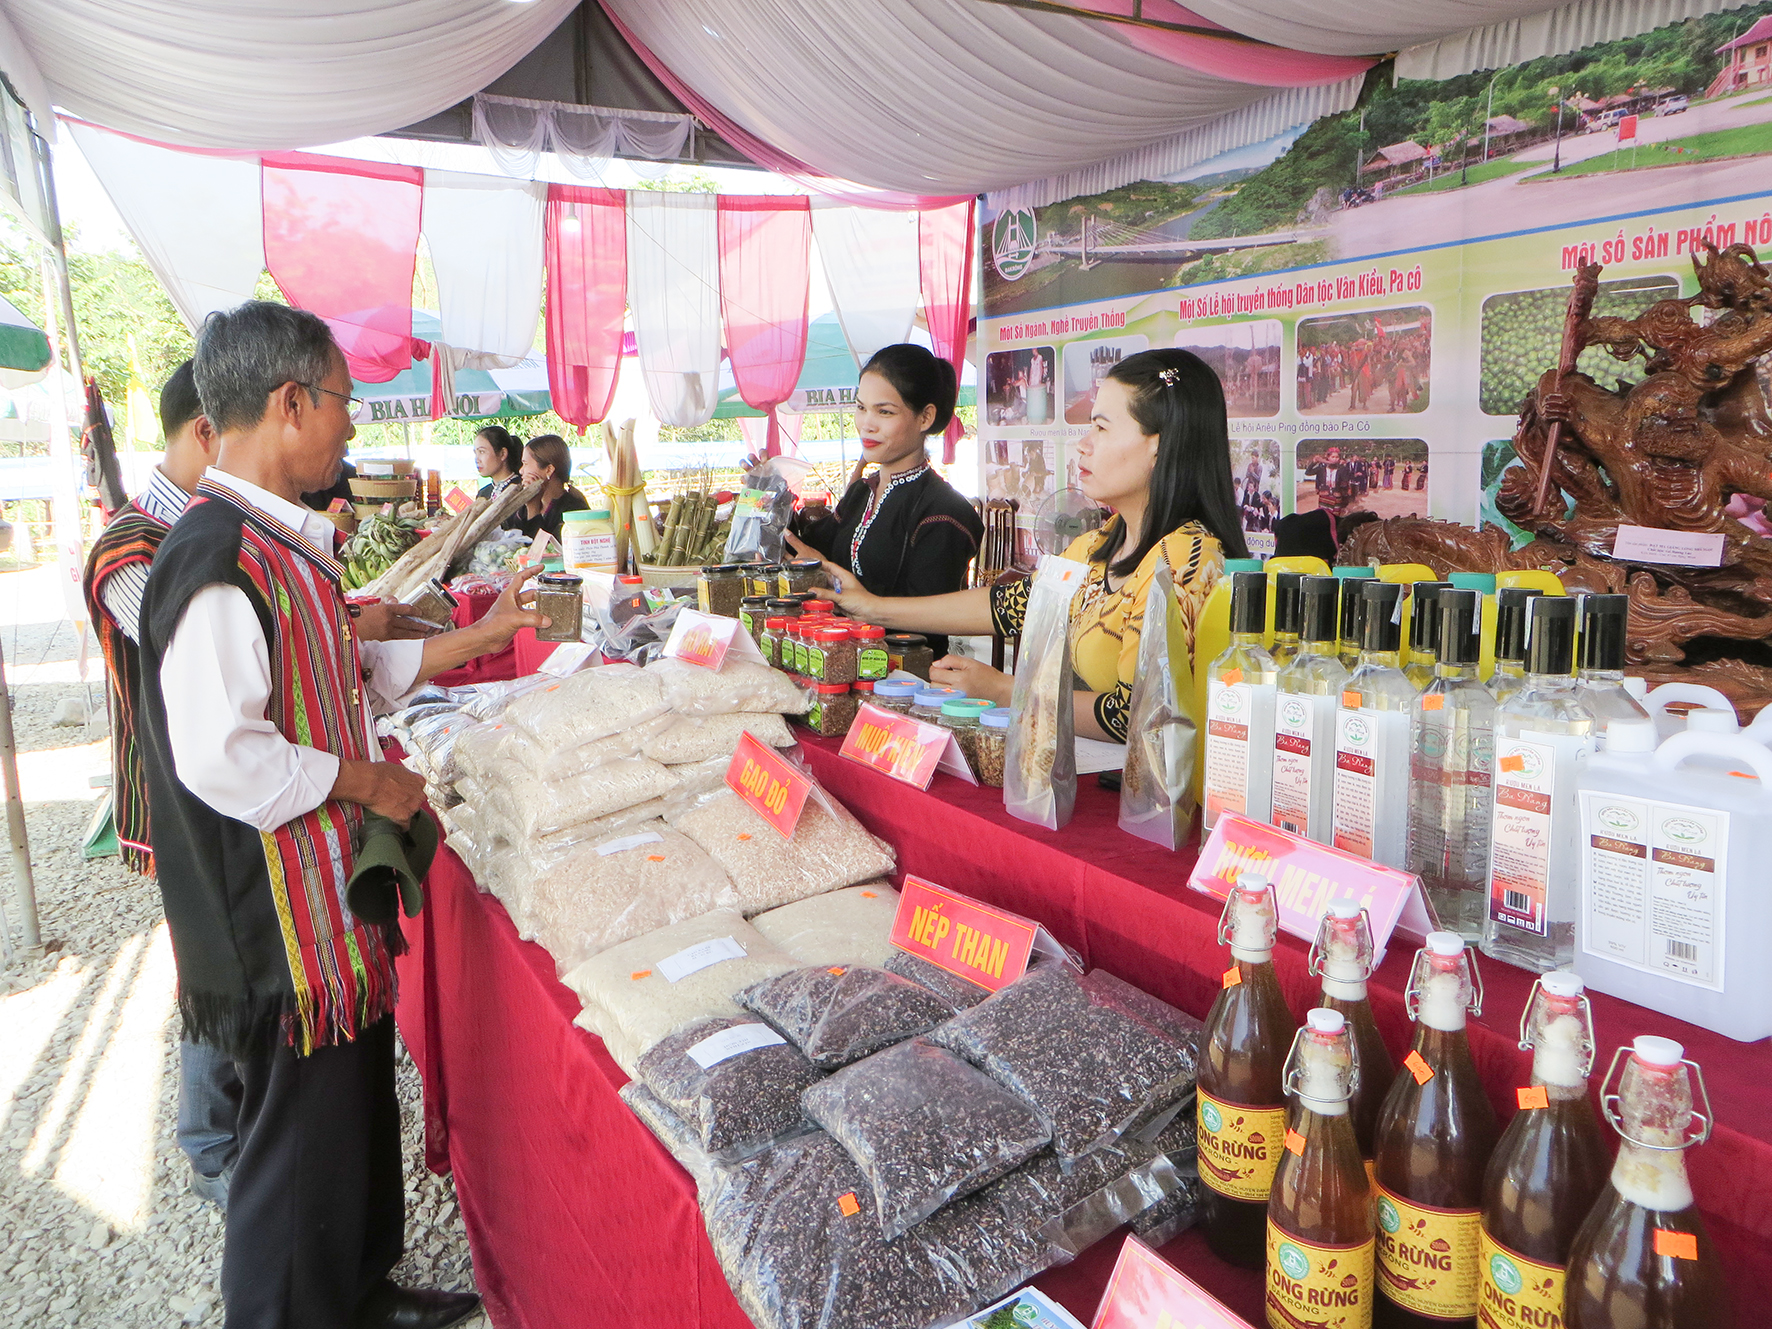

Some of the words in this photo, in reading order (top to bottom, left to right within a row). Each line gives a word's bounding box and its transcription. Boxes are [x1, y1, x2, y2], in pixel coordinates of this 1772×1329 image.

[1602, 229, 1626, 265] SỐ
[1631, 227, 1669, 261] SẢN
[1676, 214, 1736, 255] PHẨM
[1179, 299, 1195, 322] Một
[1196, 293, 1208, 317] Số
[1209, 292, 1219, 316] Lễ
[1221, 293, 1235, 319] hội
[1237, 285, 1266, 314] truyền
[1267, 282, 1294, 309] thống
[1296, 283, 1315, 305] Dân
[1317, 280, 1333, 308] tộc
[1336, 275, 1355, 300] Vân
[1358, 268, 1386, 297] Kiều,
[1390, 269, 1404, 293] Pa
[1407, 265, 1422, 291] cô
[999, 326, 1013, 343] Một
[1014, 321, 1024, 339] Số
[1025, 323, 1049, 339] Ngành,
[1050, 314, 1069, 336] Nghề
[1071, 310, 1099, 332] Truyền
[1100, 307, 1126, 328] Thống
[369, 399, 409, 421] BIA
[410, 395, 432, 416] H
[805, 389, 837, 406] BIA
[1278, 422, 1297, 434] Ping
[1299, 420, 1320, 434] đồng
[1322, 421, 1339, 432] bào
[1341, 421, 1354, 431] Pa
[1356, 420, 1371, 431] Cô
[854, 722, 894, 760] MUỐI
[739, 758, 769, 798] GẠO
[763, 778, 791, 815] ĐỎ
[1498, 786, 1515, 799] Ba
[1517, 791, 1548, 811] Nang
[1514, 815, 1530, 824] ngon
[1599, 837, 1613, 847] Ba
[1661, 851, 1676, 860] Ba
[1277, 863, 1339, 922] MEN
[907, 903, 951, 950] NẾP
[951, 922, 1010, 980] THAN
[1199, 1125, 1220, 1150] ONG
[1222, 1140, 1267, 1160] RỪNG
[1399, 1243, 1452, 1271] RỪNG
[1272, 1269, 1303, 1301] ONG
[1308, 1287, 1358, 1307] RỪNG
[1484, 1281, 1516, 1317] ONG
